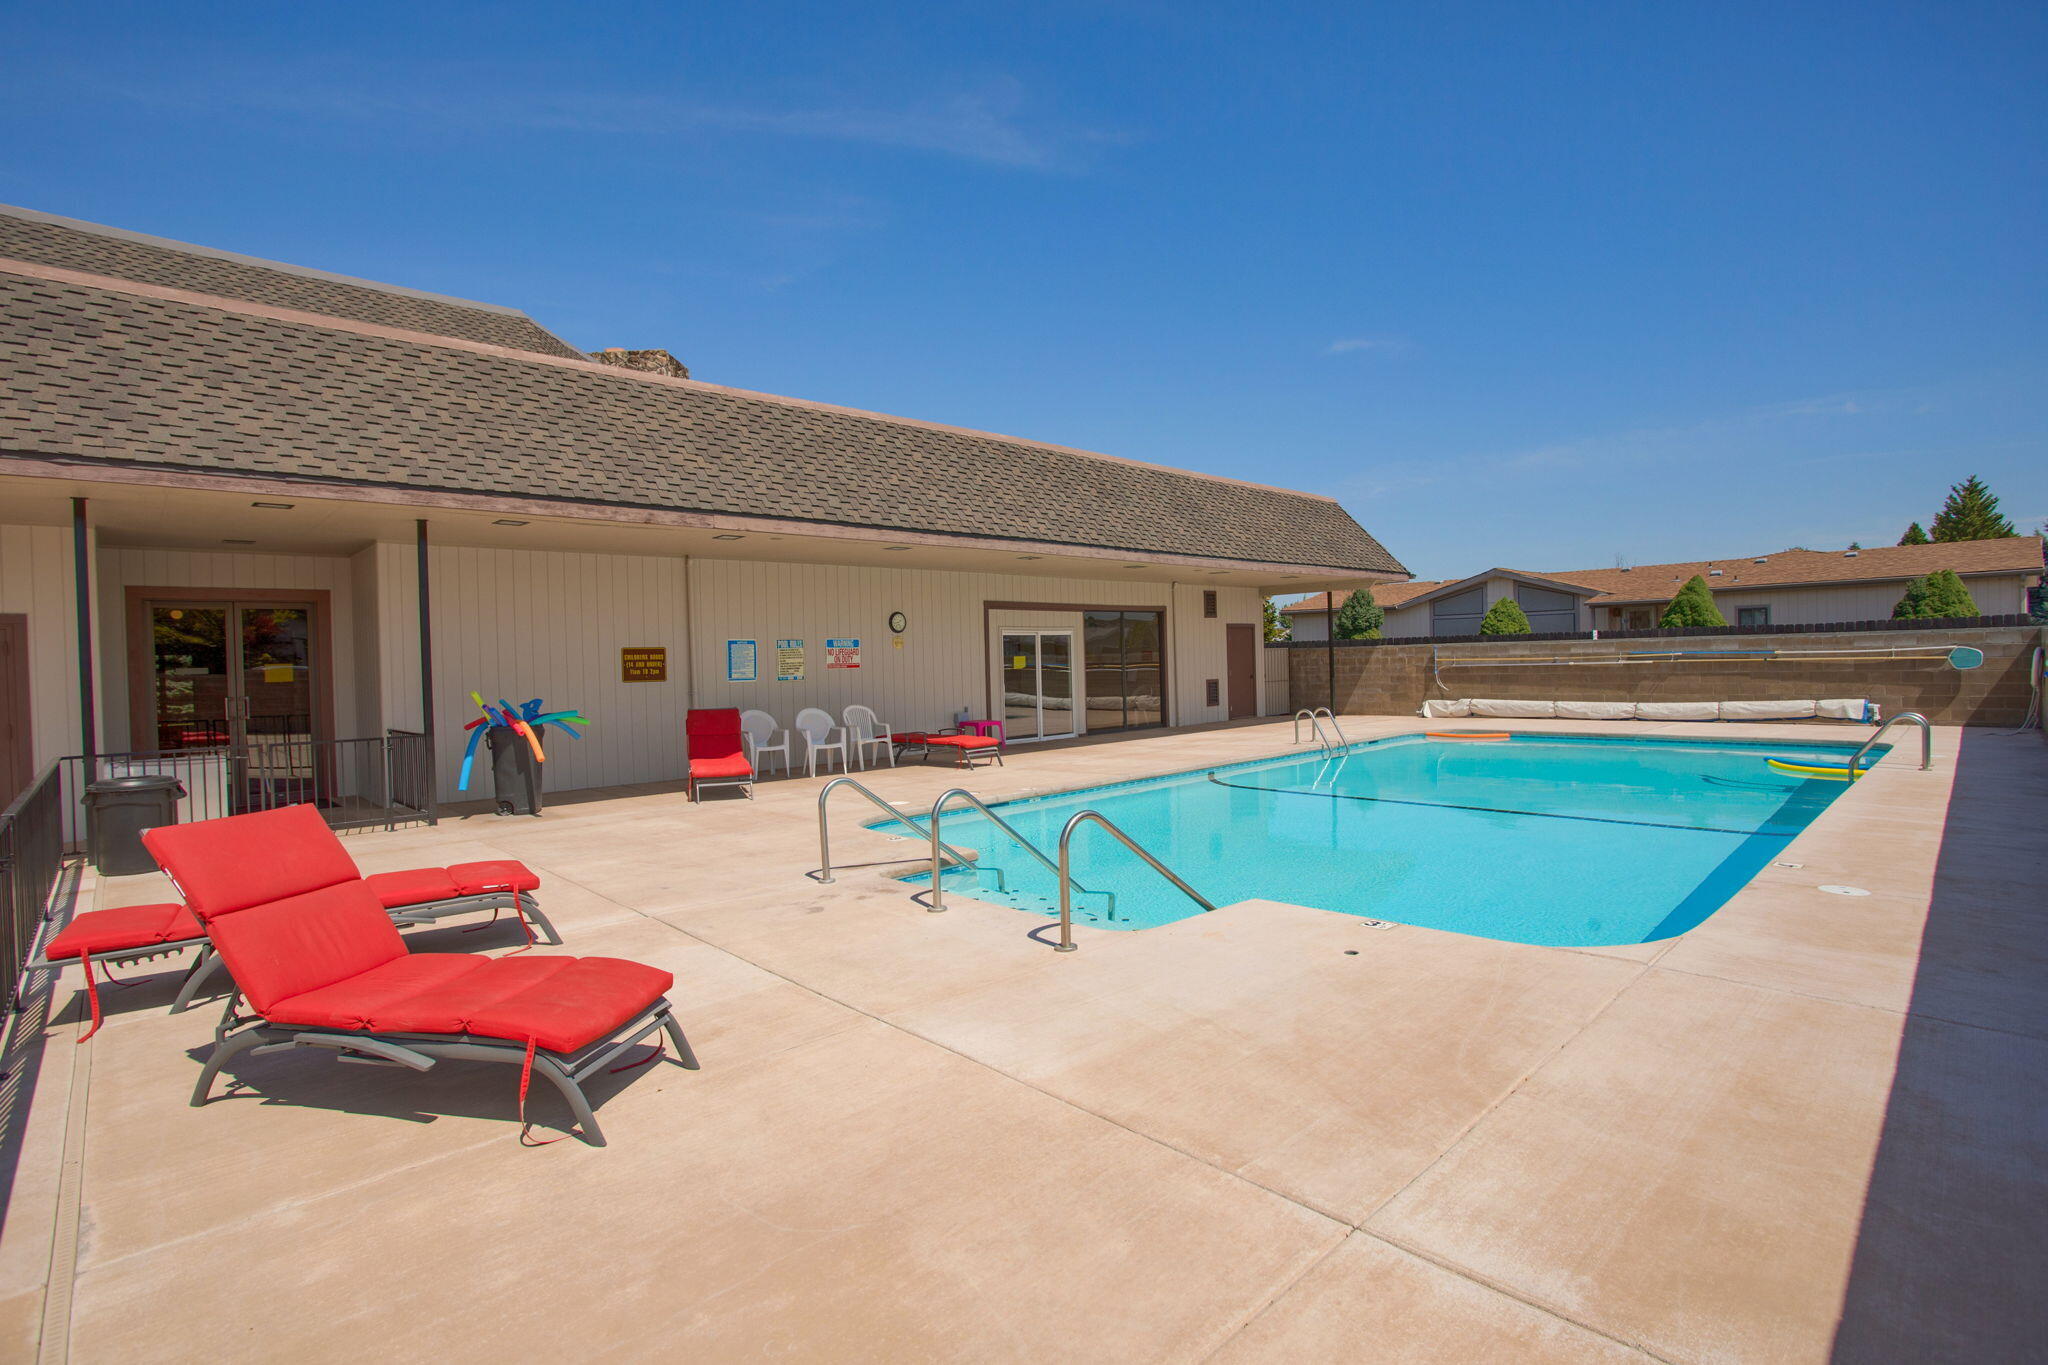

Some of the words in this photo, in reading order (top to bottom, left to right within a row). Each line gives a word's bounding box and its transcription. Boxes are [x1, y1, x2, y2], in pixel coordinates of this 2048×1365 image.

[778, 640, 789, 648] POOL
[828, 648, 834, 656] NO
[835, 648, 860, 656] LIFEGUARD
[834, 655, 841, 664] ON
[842, 655, 853, 664] DUTY
